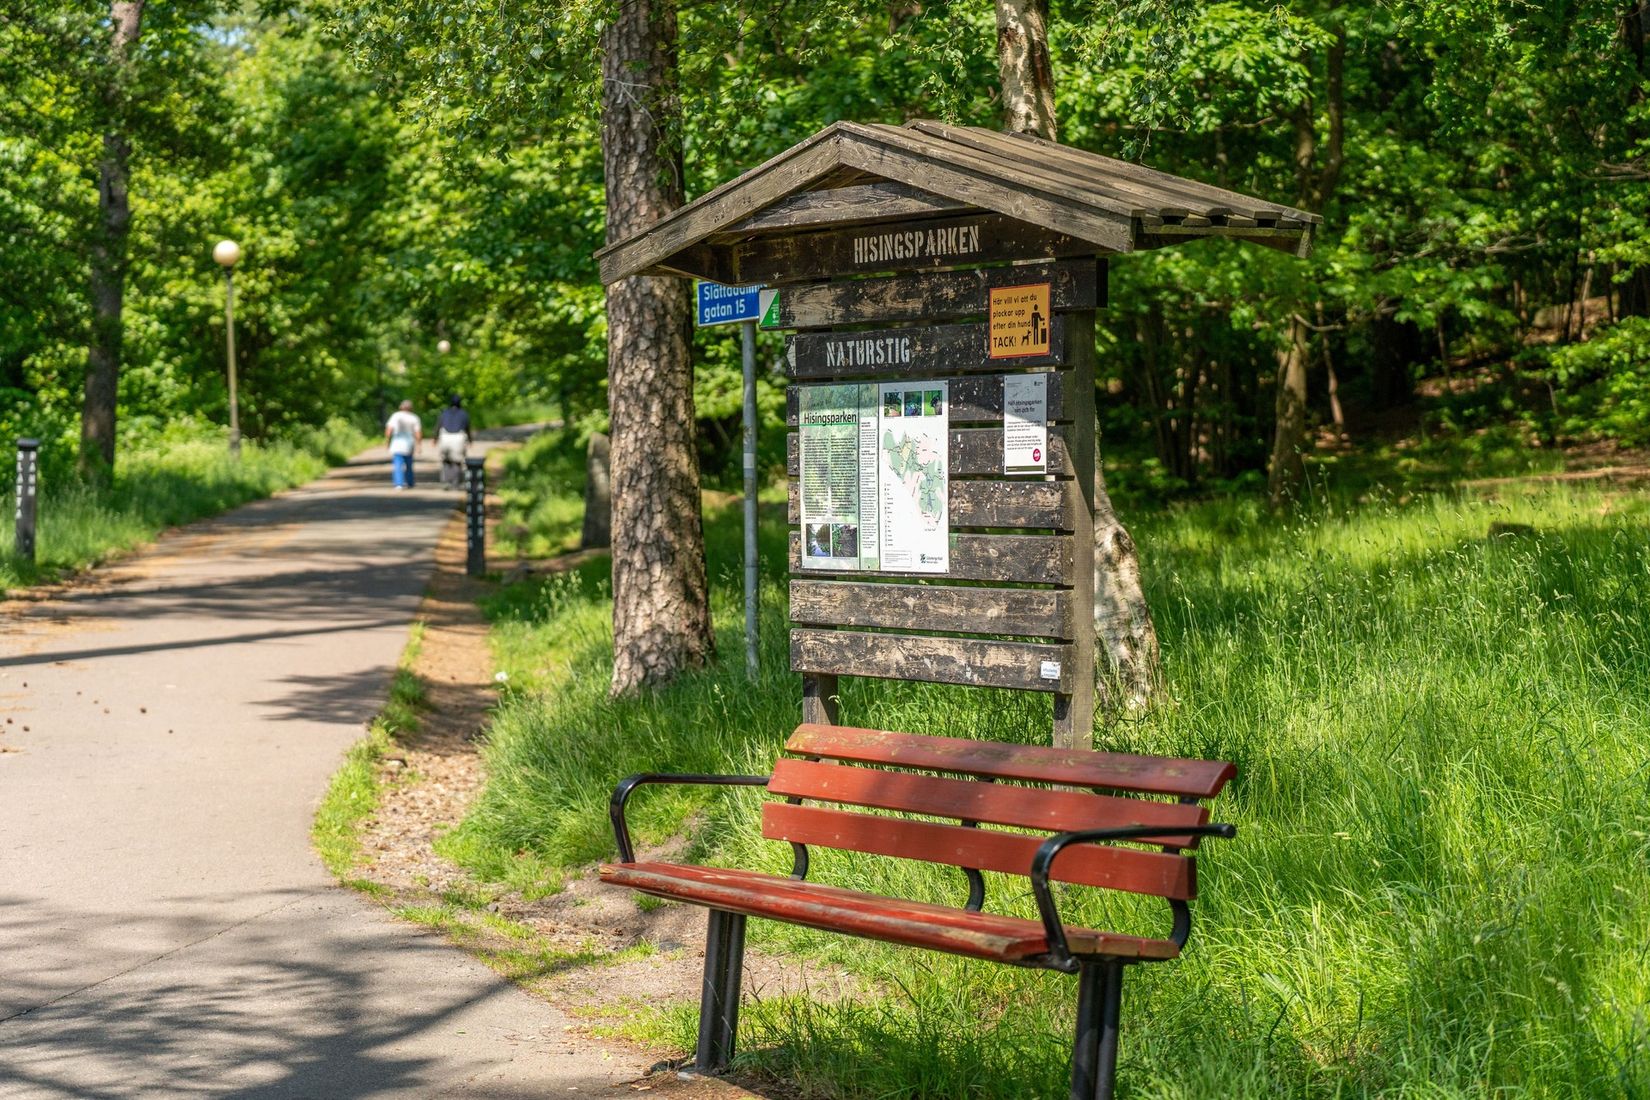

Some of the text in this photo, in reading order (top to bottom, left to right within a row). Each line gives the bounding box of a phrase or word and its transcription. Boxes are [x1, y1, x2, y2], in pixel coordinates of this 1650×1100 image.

[854, 225, 979, 264] HISINGSPARKEN
[704, 299, 745, 322] gatan 15
[993, 309, 1025, 319] plockar upp
[993, 336, 1016, 348] TACK!
[826, 338, 910, 367] NATURSTIG
[804, 411, 857, 427] Hisingsparken
